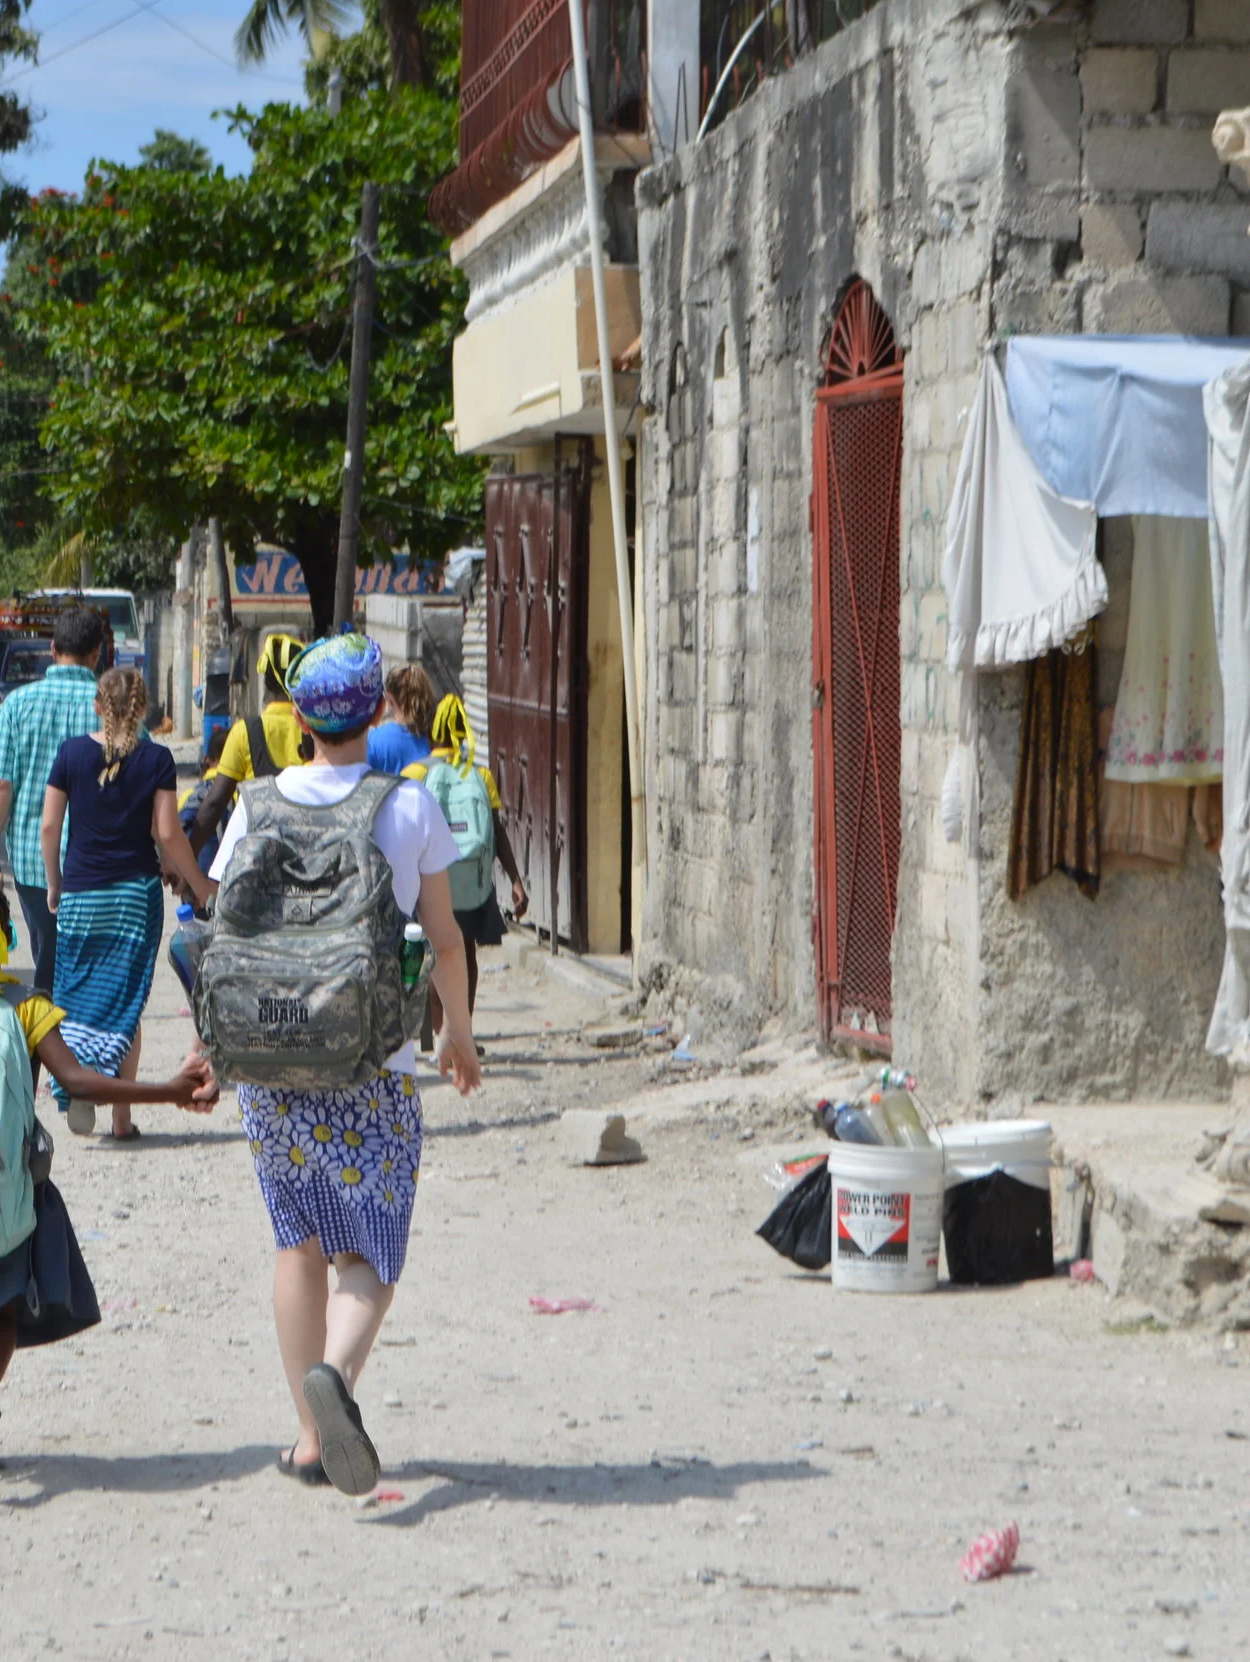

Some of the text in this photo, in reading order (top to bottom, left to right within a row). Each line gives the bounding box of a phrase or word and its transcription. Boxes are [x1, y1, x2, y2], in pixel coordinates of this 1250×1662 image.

[258, 1007, 309, 1024] GUARD
[872, 1193, 905, 1206] POINT
[874, 1207, 905, 1218] PINS
